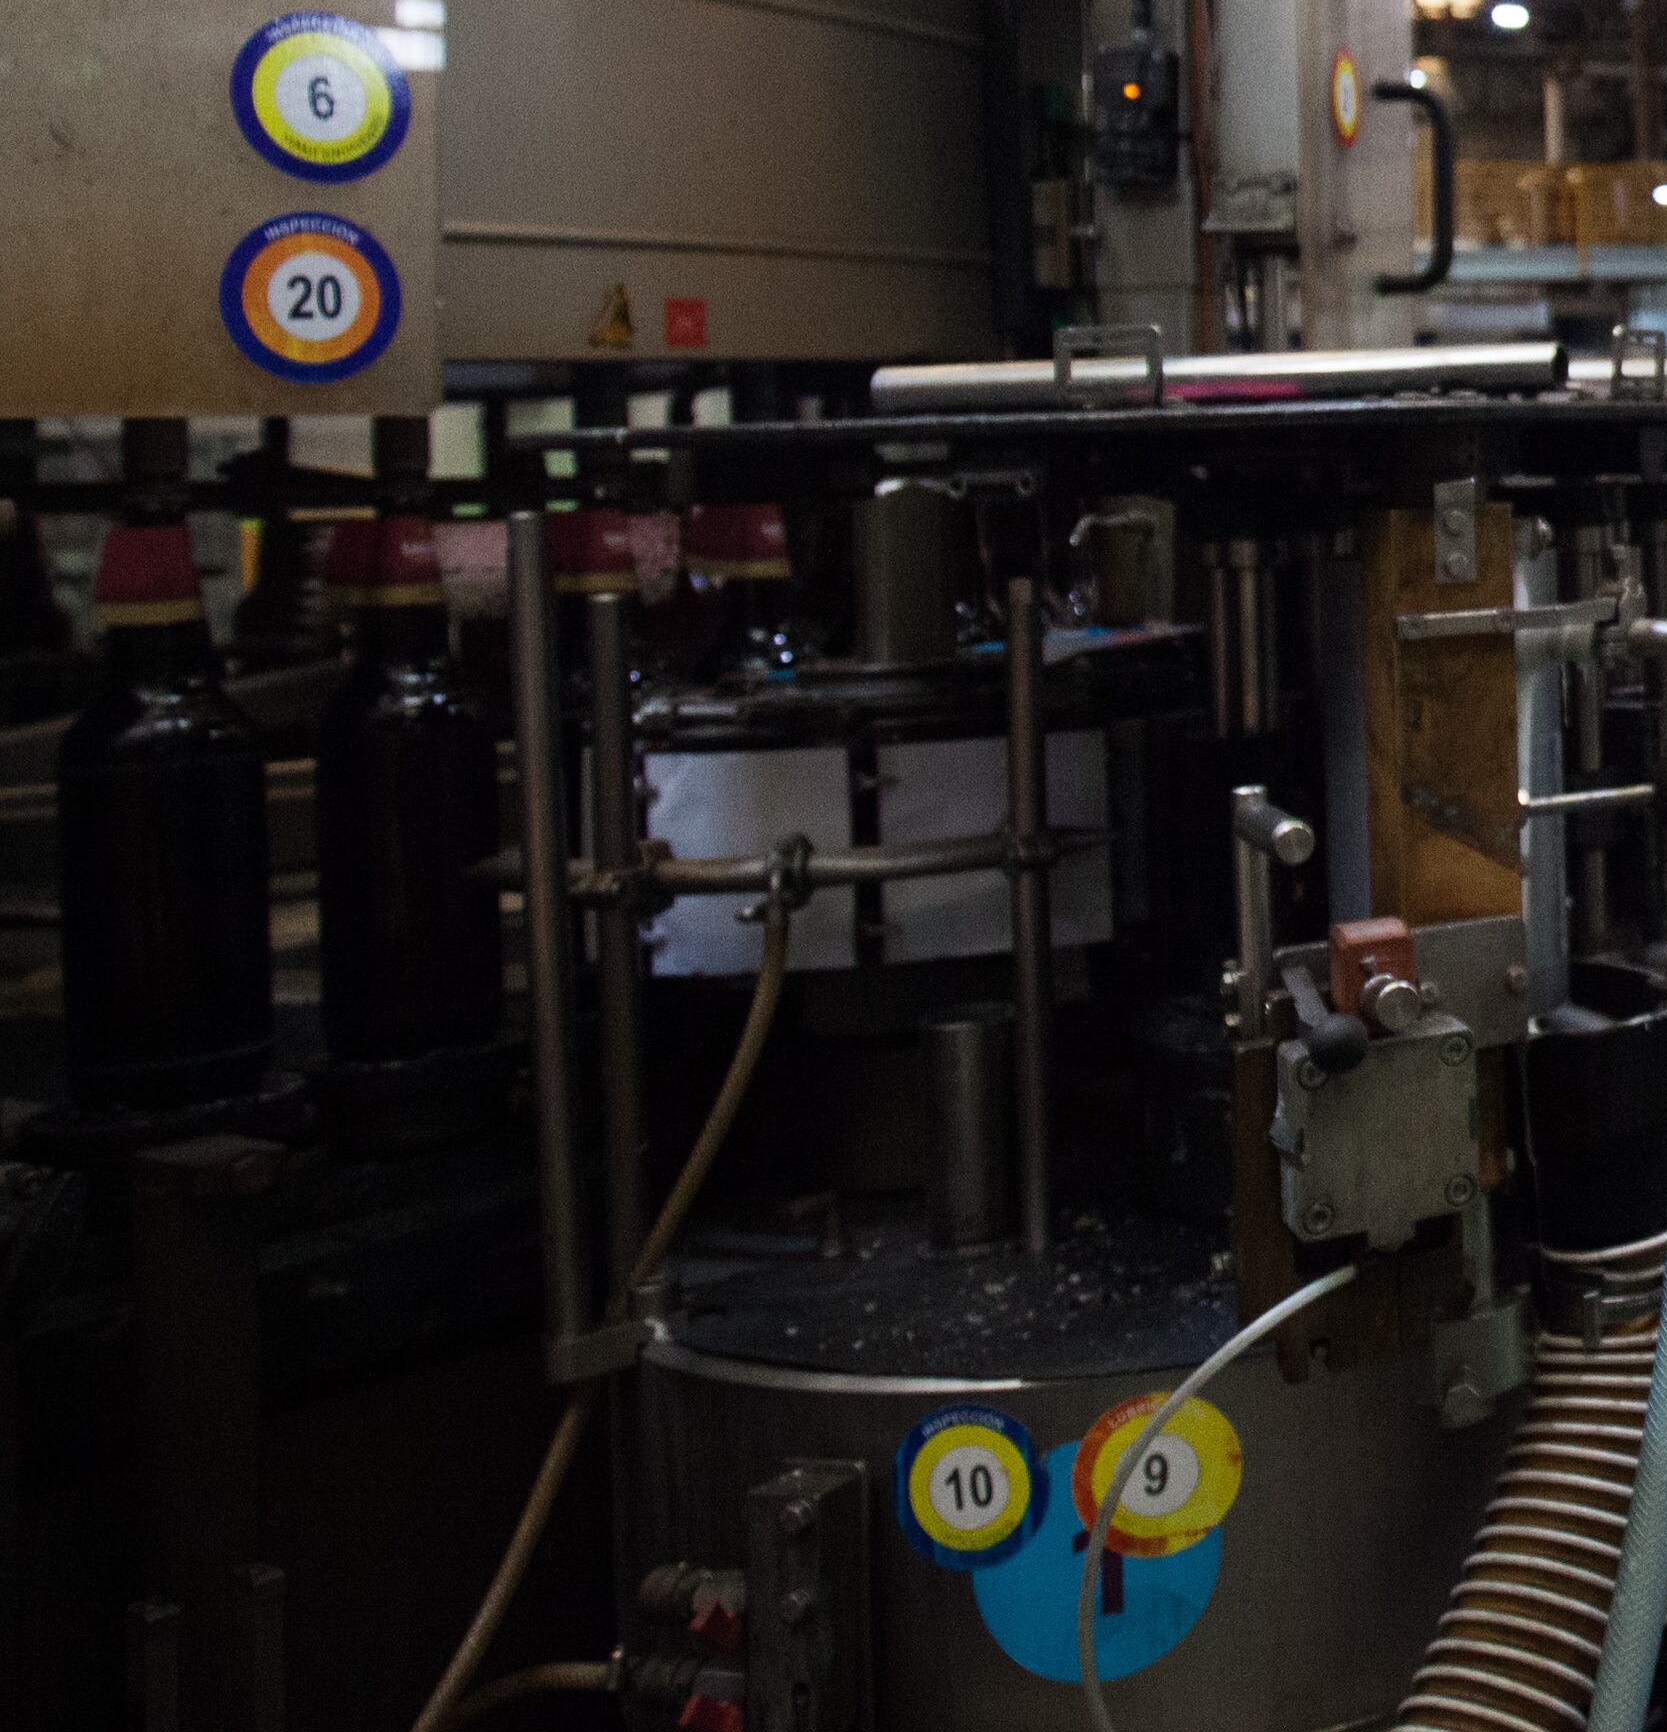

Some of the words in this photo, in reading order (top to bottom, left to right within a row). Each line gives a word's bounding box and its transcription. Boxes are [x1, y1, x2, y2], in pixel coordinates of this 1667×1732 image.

[308, 76, 335, 120] 6
[287, 274, 342, 319] 20
[944, 1463, 994, 1511] 10
[1143, 1452, 1169, 1497] 9
